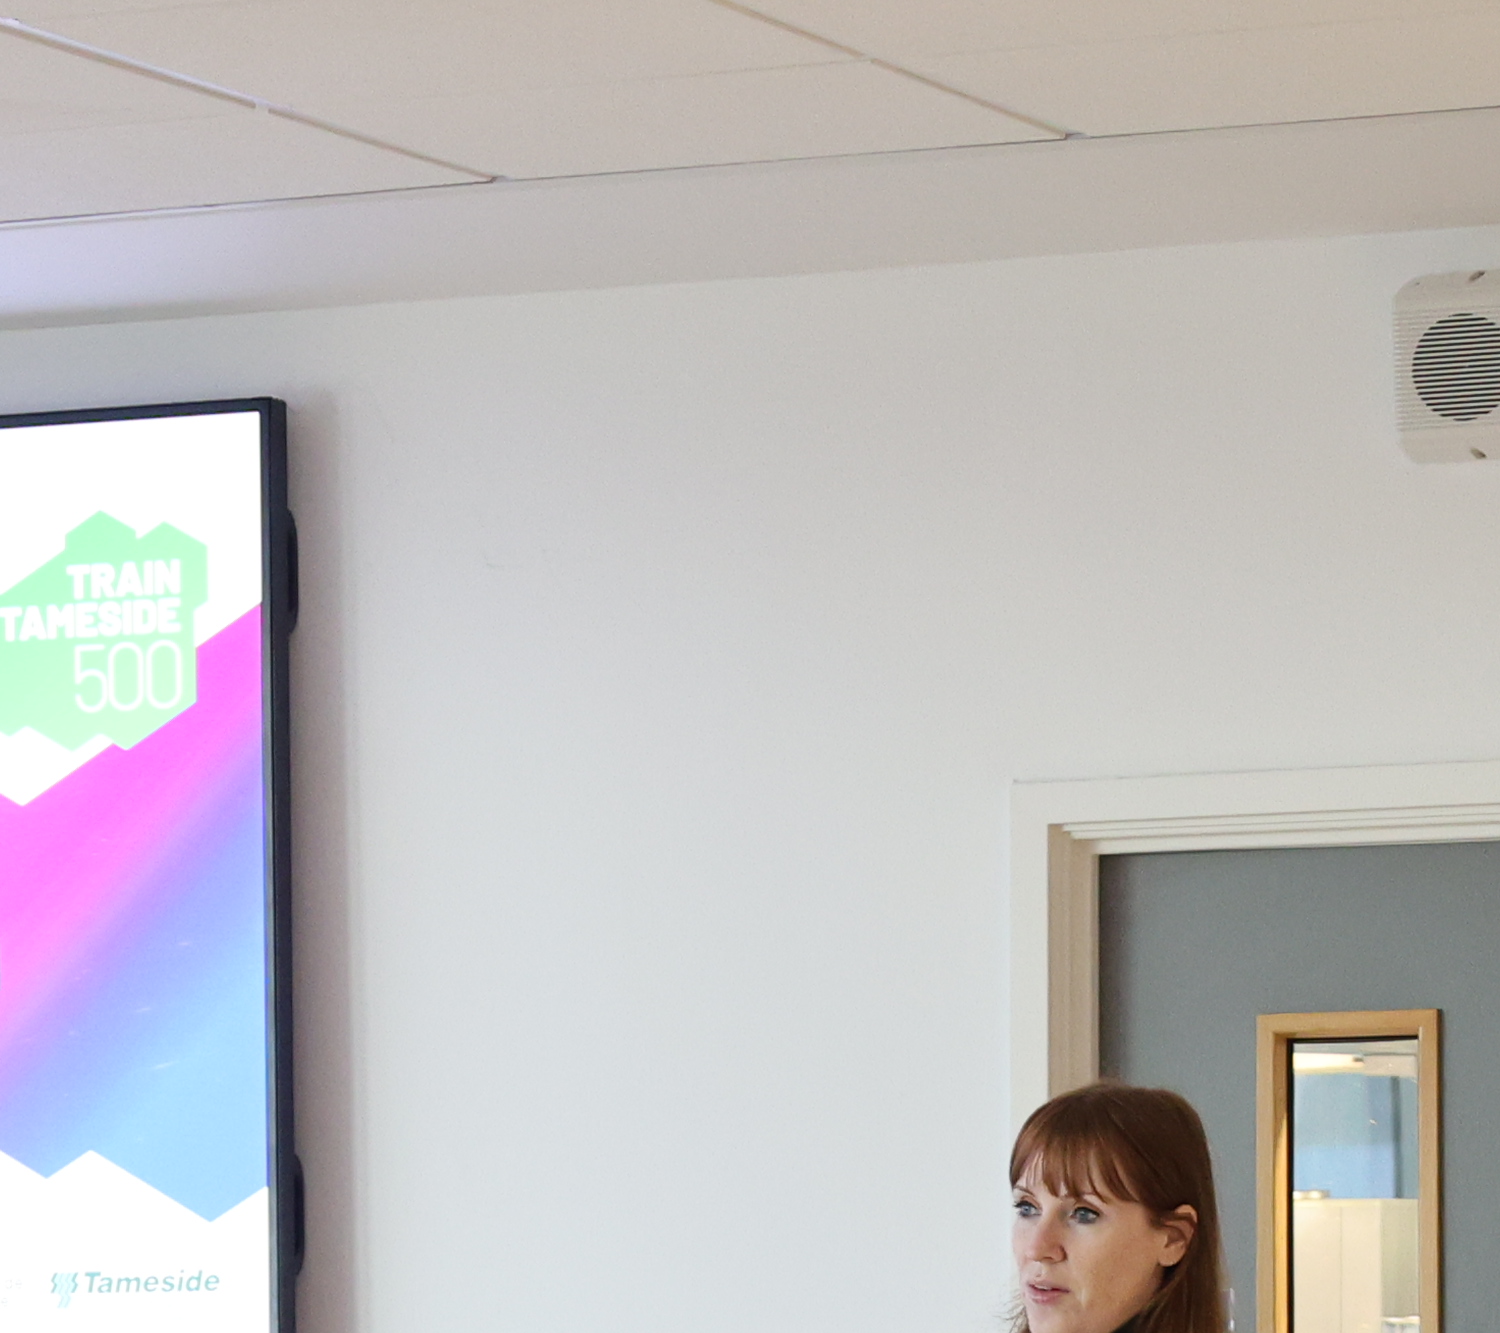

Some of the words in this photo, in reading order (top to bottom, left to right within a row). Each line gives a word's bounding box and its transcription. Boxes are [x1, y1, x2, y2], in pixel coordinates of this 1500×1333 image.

[66, 559, 181, 599] TRAIN
[74, 640, 182, 713] 500
[84, 1270, 220, 1294] Tameside
